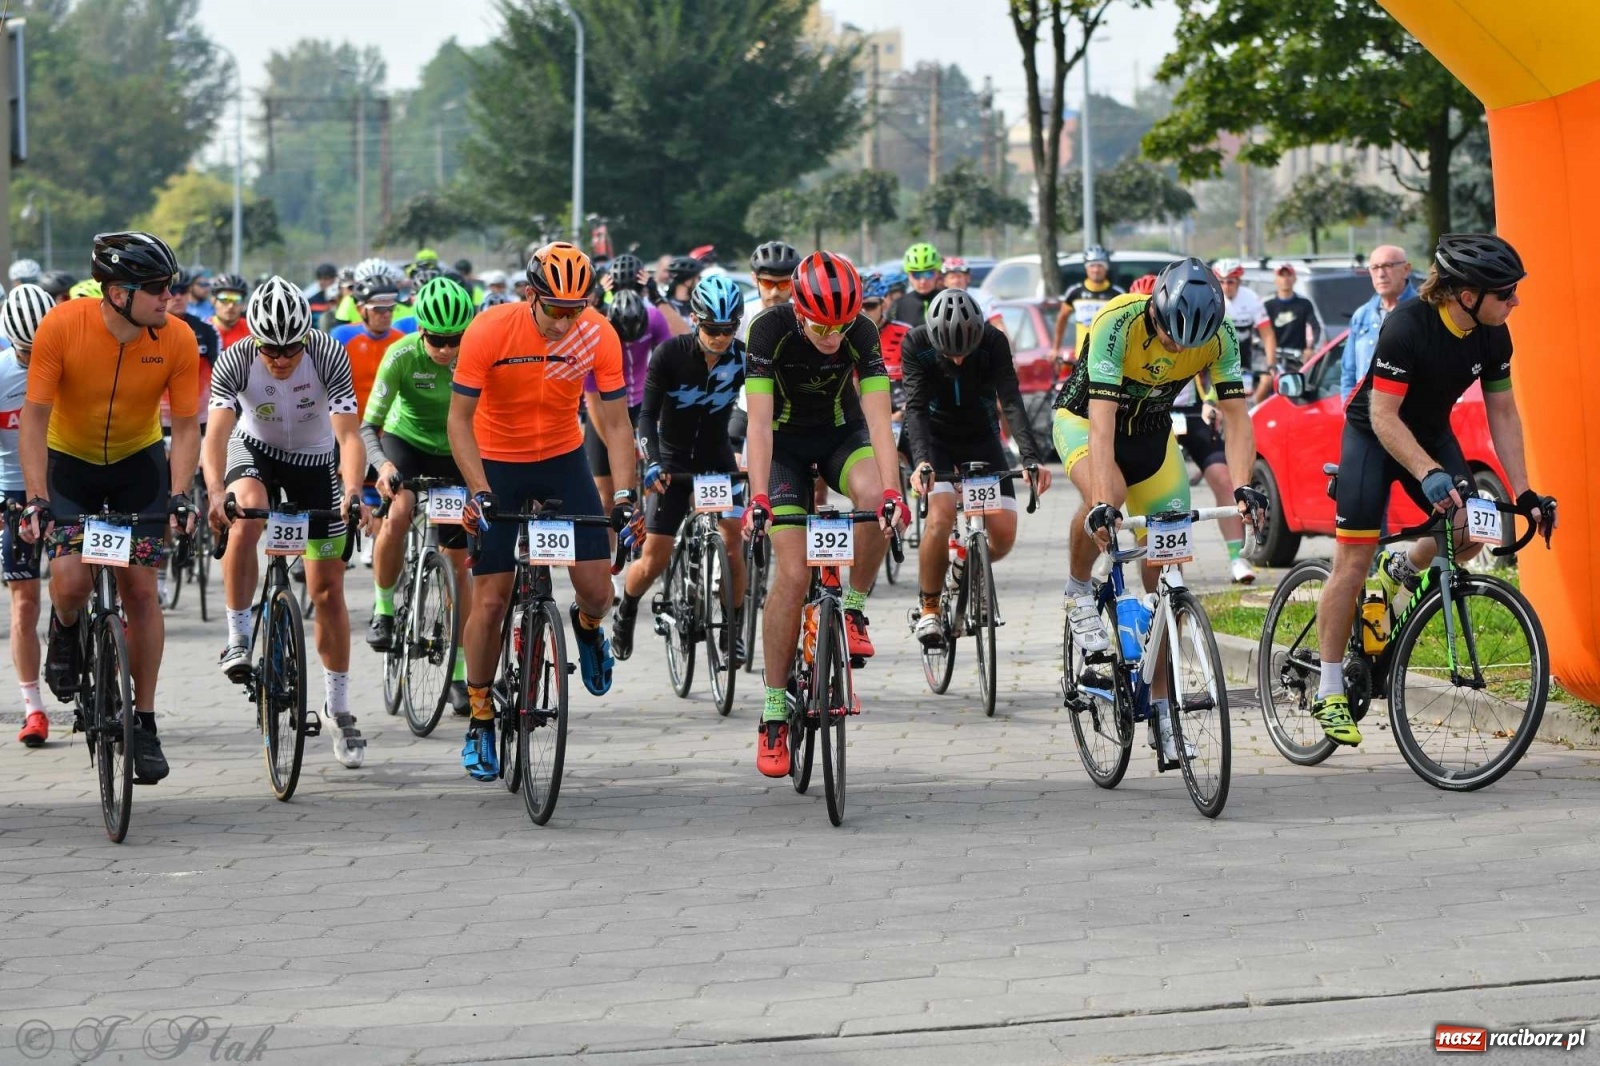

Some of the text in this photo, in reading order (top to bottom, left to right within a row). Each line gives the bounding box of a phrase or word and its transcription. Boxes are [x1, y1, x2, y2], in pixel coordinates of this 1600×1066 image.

[141, 356, 164, 364] LUXA
[700, 485, 727, 499] 385
[968, 487, 996, 502] 383
[435, 498, 463, 510] 389
[1473, 510, 1496, 528] 377
[90, 532, 126, 550] 387
[273, 525, 304, 541] 381
[536, 533, 570, 549] 380
[814, 532, 848, 549] 392
[1154, 531, 1188, 550] 384
